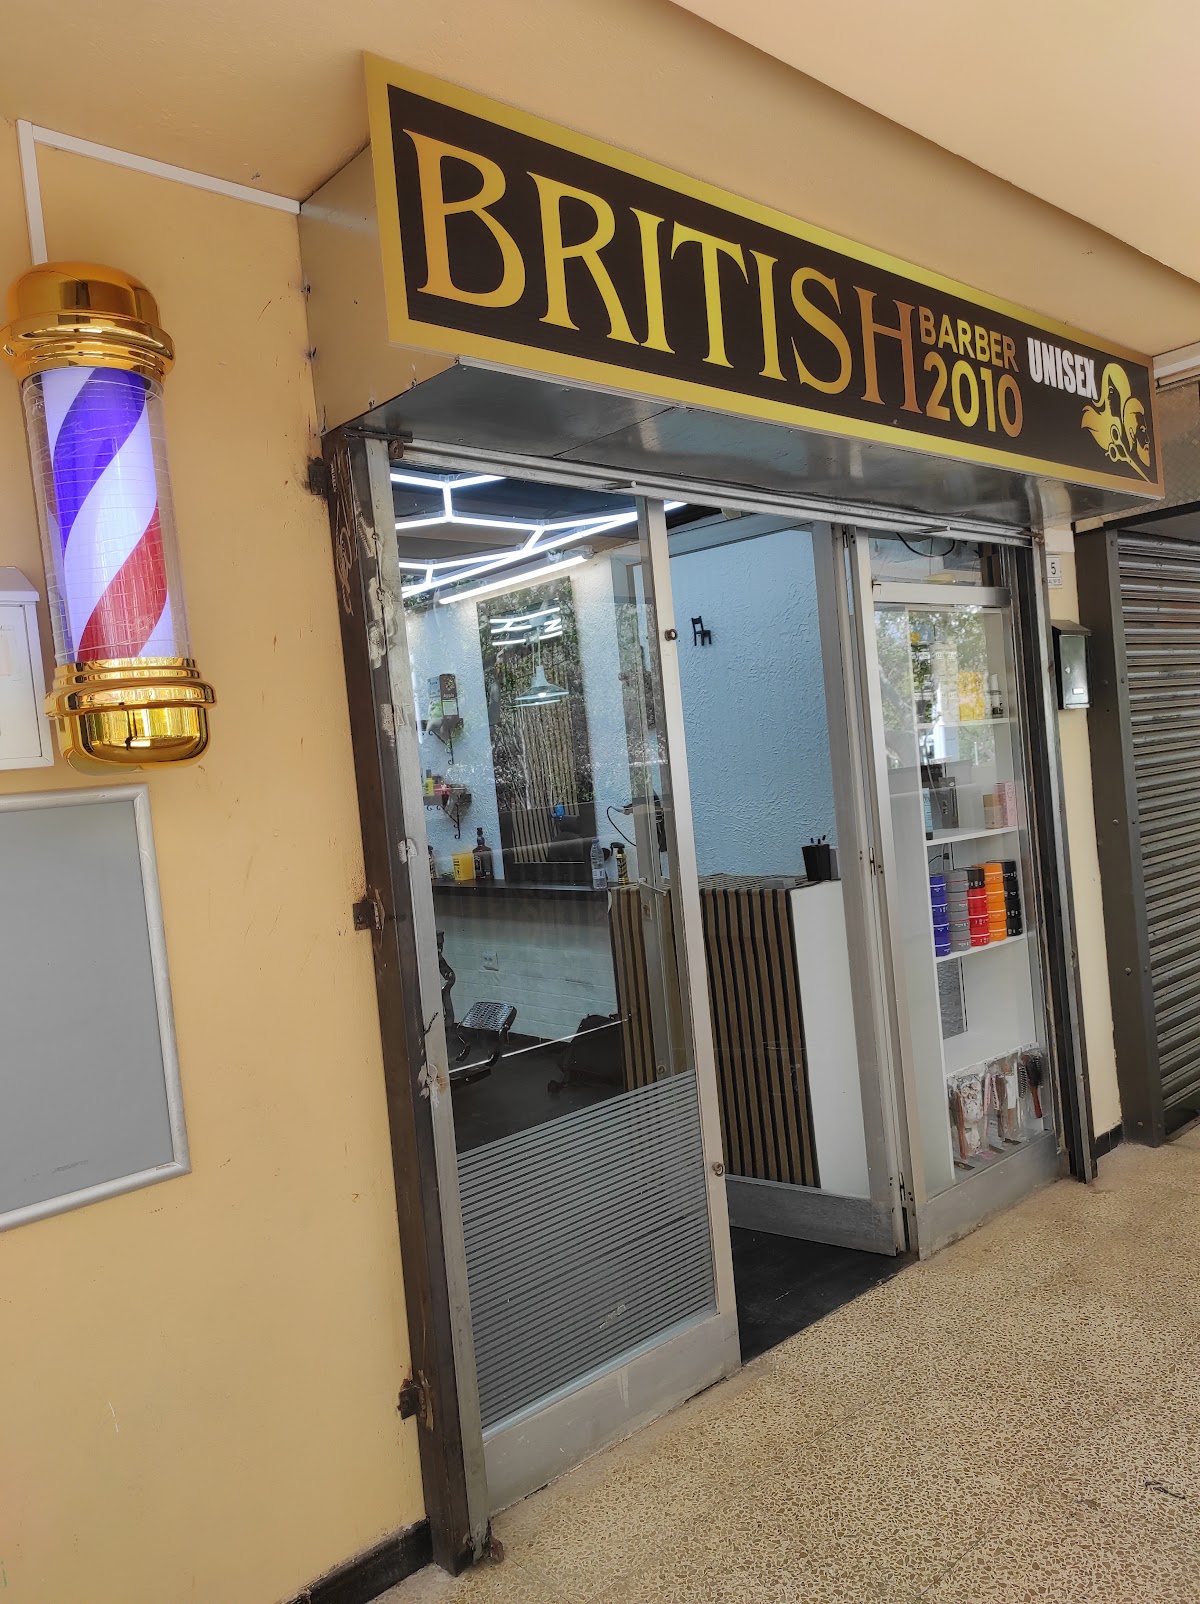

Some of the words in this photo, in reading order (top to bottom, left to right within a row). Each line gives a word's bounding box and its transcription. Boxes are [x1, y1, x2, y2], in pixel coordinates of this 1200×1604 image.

[403, 129, 922, 413] BRITISH
[919, 305, 1020, 373] BARBER
[1026, 336, 1099, 401] UNISEX
[923, 351, 1024, 438] 2010
[1050, 562, 1057, 575] 5
